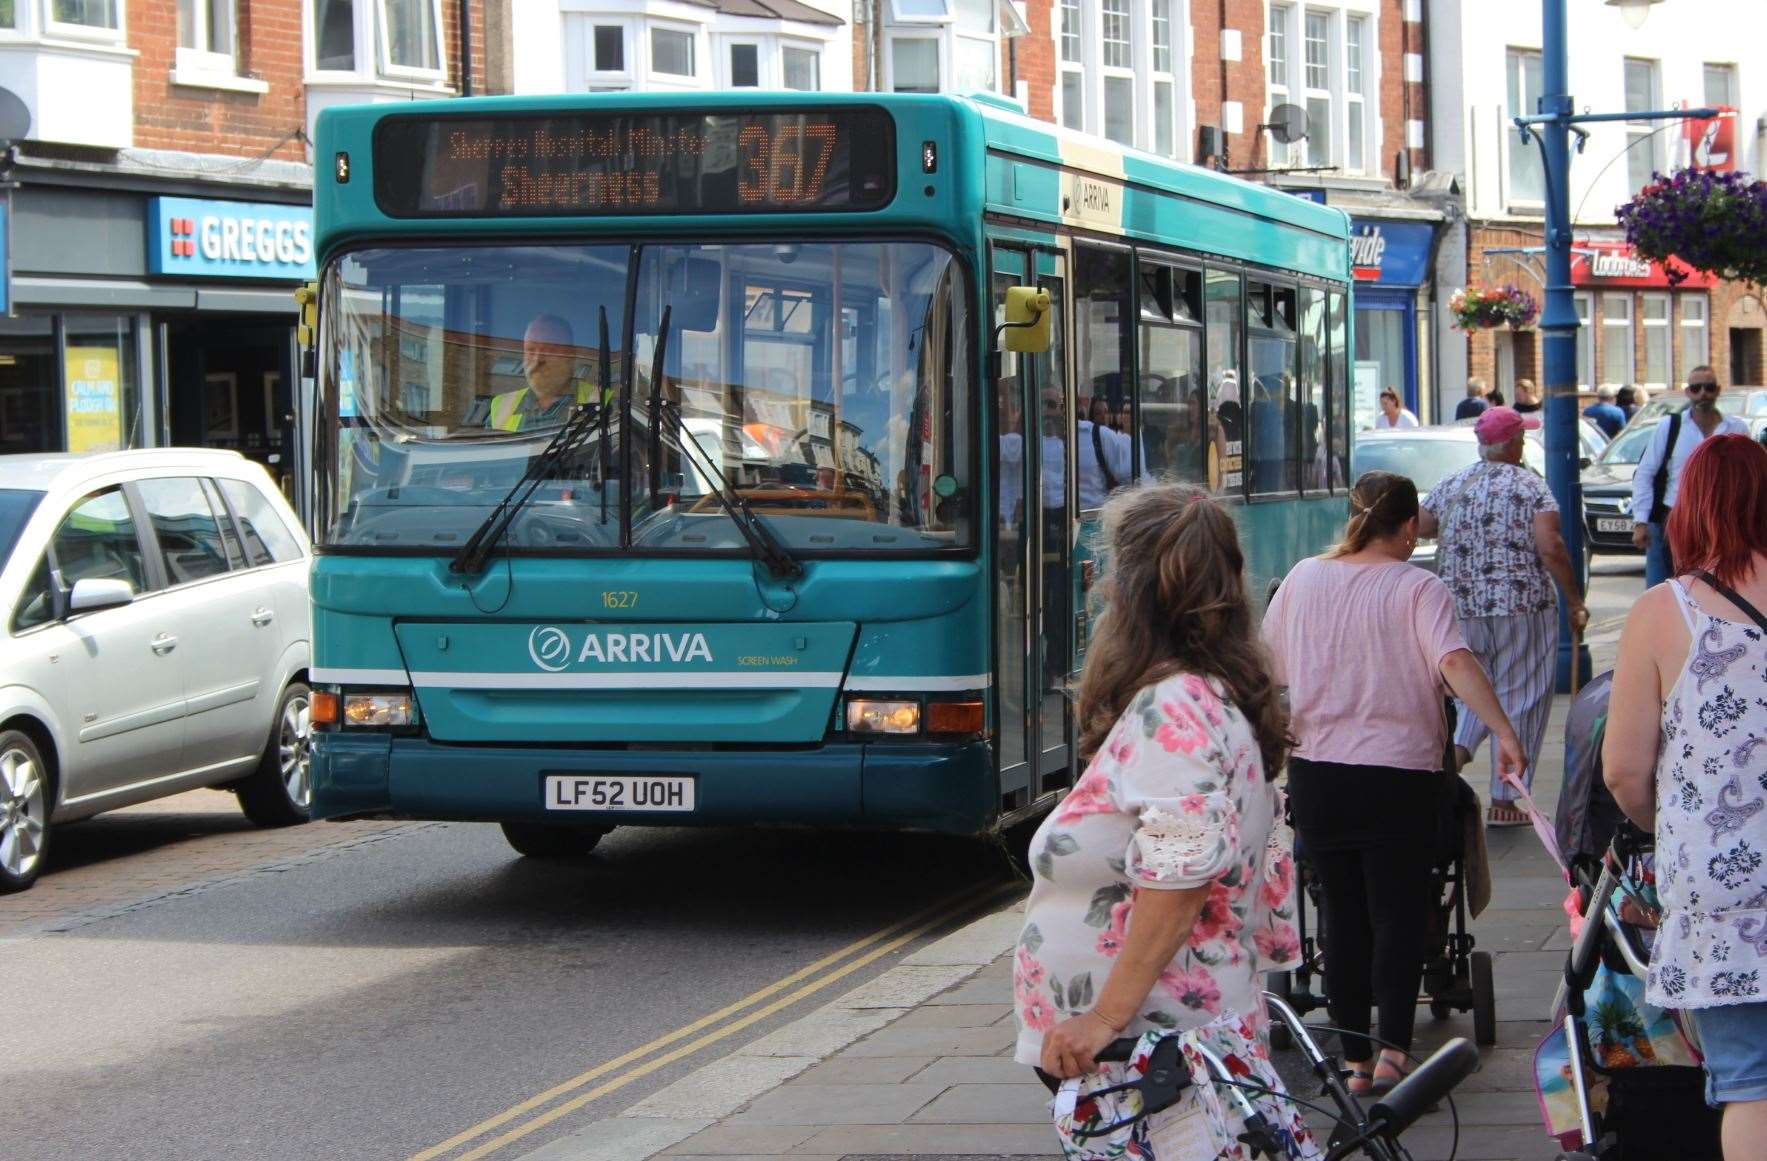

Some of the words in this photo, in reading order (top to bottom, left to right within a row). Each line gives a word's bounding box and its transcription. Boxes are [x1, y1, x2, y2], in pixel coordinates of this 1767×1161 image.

[738, 124, 837, 201] 367
[500, 165, 660, 206] Sheerness
[1083, 183, 1110, 214] ARRIVA
[201, 215, 311, 265] GREGGS
[601, 591, 639, 608] 1627
[578, 633, 714, 663] ARRIVA
[736, 656, 769, 666] SCREEN
[769, 656, 799, 666] WASH
[556, 781, 625, 806] LF52
[632, 781, 684, 806] UOH
